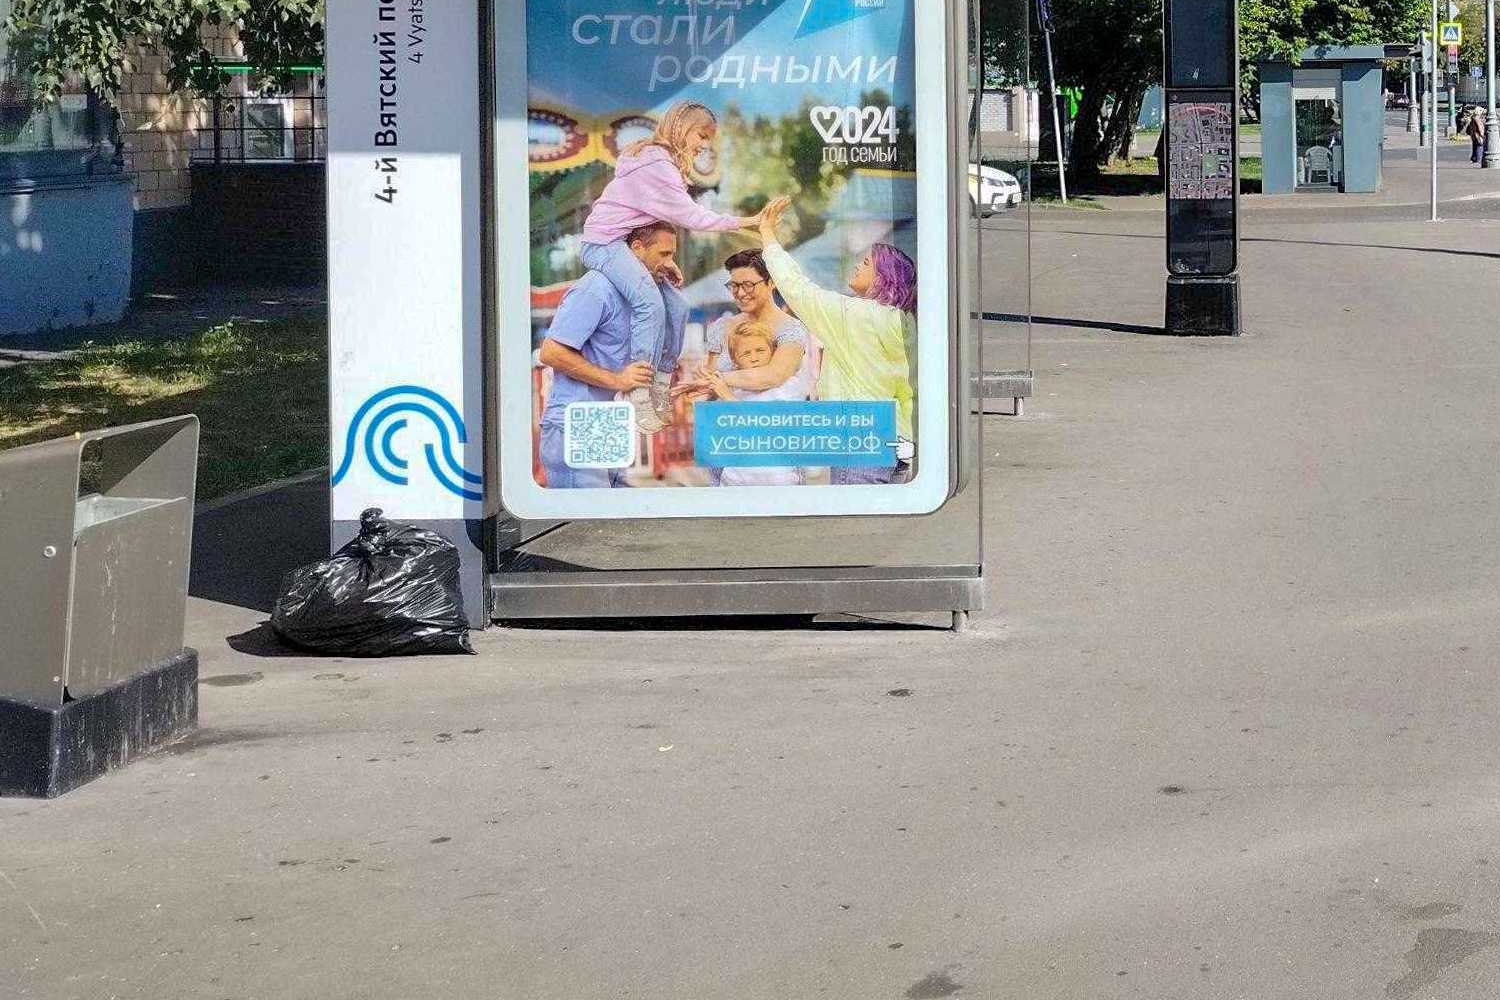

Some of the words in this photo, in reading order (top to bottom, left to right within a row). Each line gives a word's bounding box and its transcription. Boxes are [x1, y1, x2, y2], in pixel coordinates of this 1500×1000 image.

[571, 14, 736, 46] стали
[408, 52, 423, 64] 4
[648, 55, 899, 92] родными
[373, 31, 398, 147] Вятский
[818, 106, 900, 144] 2024
[374, 157, 398, 203] 4-й
[716, 414, 832, 427] СТАНОВИТЕСЬ
[835, 414, 846, 427] И
[850, 413, 874, 427] ВЫ
[710, 431, 881, 454] усыновите.рф
